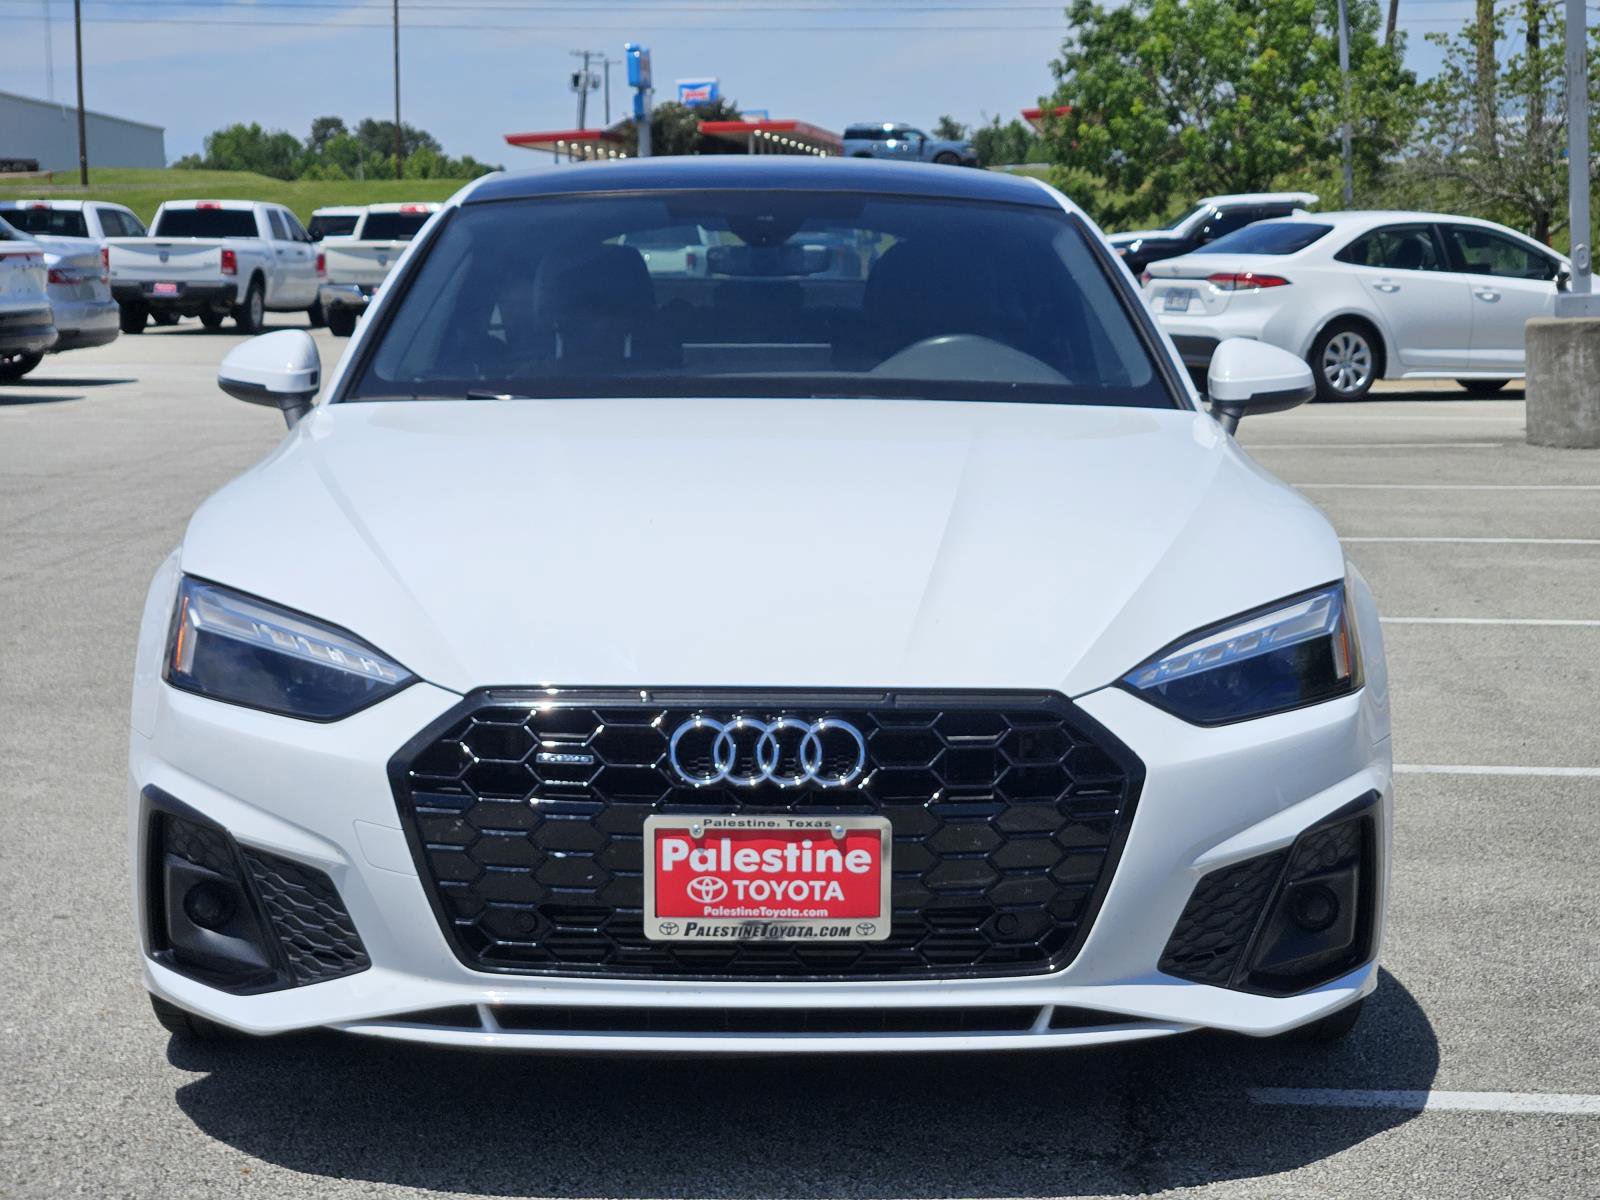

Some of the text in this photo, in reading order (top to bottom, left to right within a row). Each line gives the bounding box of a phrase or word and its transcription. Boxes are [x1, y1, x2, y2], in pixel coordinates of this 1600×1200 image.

[787, 819, 833, 828] Texas
[661, 838, 872, 873] Palestine
[732, 880, 845, 901] TOYOTA
[703, 906, 828, 918] PalestineToyota.com
